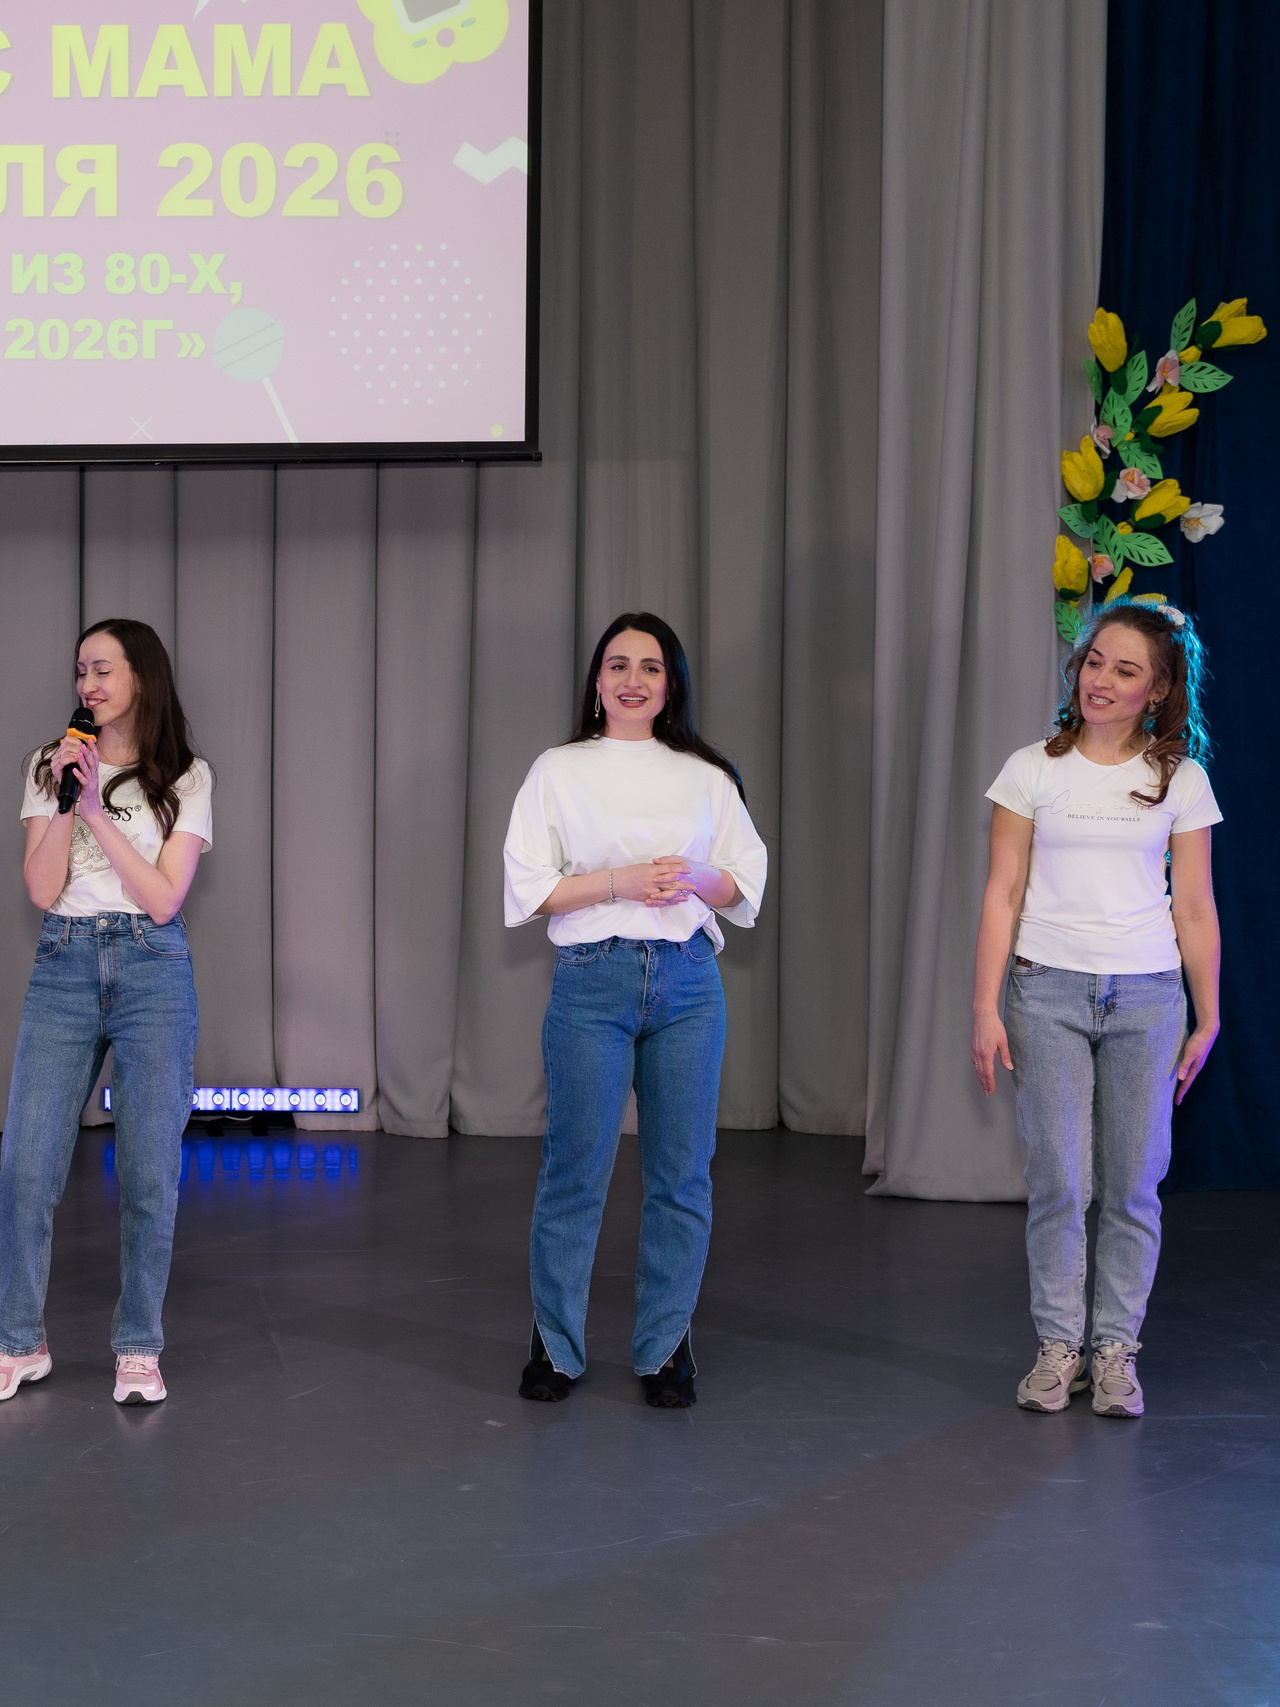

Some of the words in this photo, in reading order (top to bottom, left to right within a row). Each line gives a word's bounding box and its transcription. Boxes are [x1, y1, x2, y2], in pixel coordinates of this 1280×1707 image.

[51, 23, 371, 99] МАМА
[156, 141, 404, 219] 2026
[11, 252, 87, 296] ИЗ
[104, 252, 243, 305] 80-Х,
[3, 317, 207, 361] 2026Г»
[1067, 813, 1096, 821] BELIEVE
